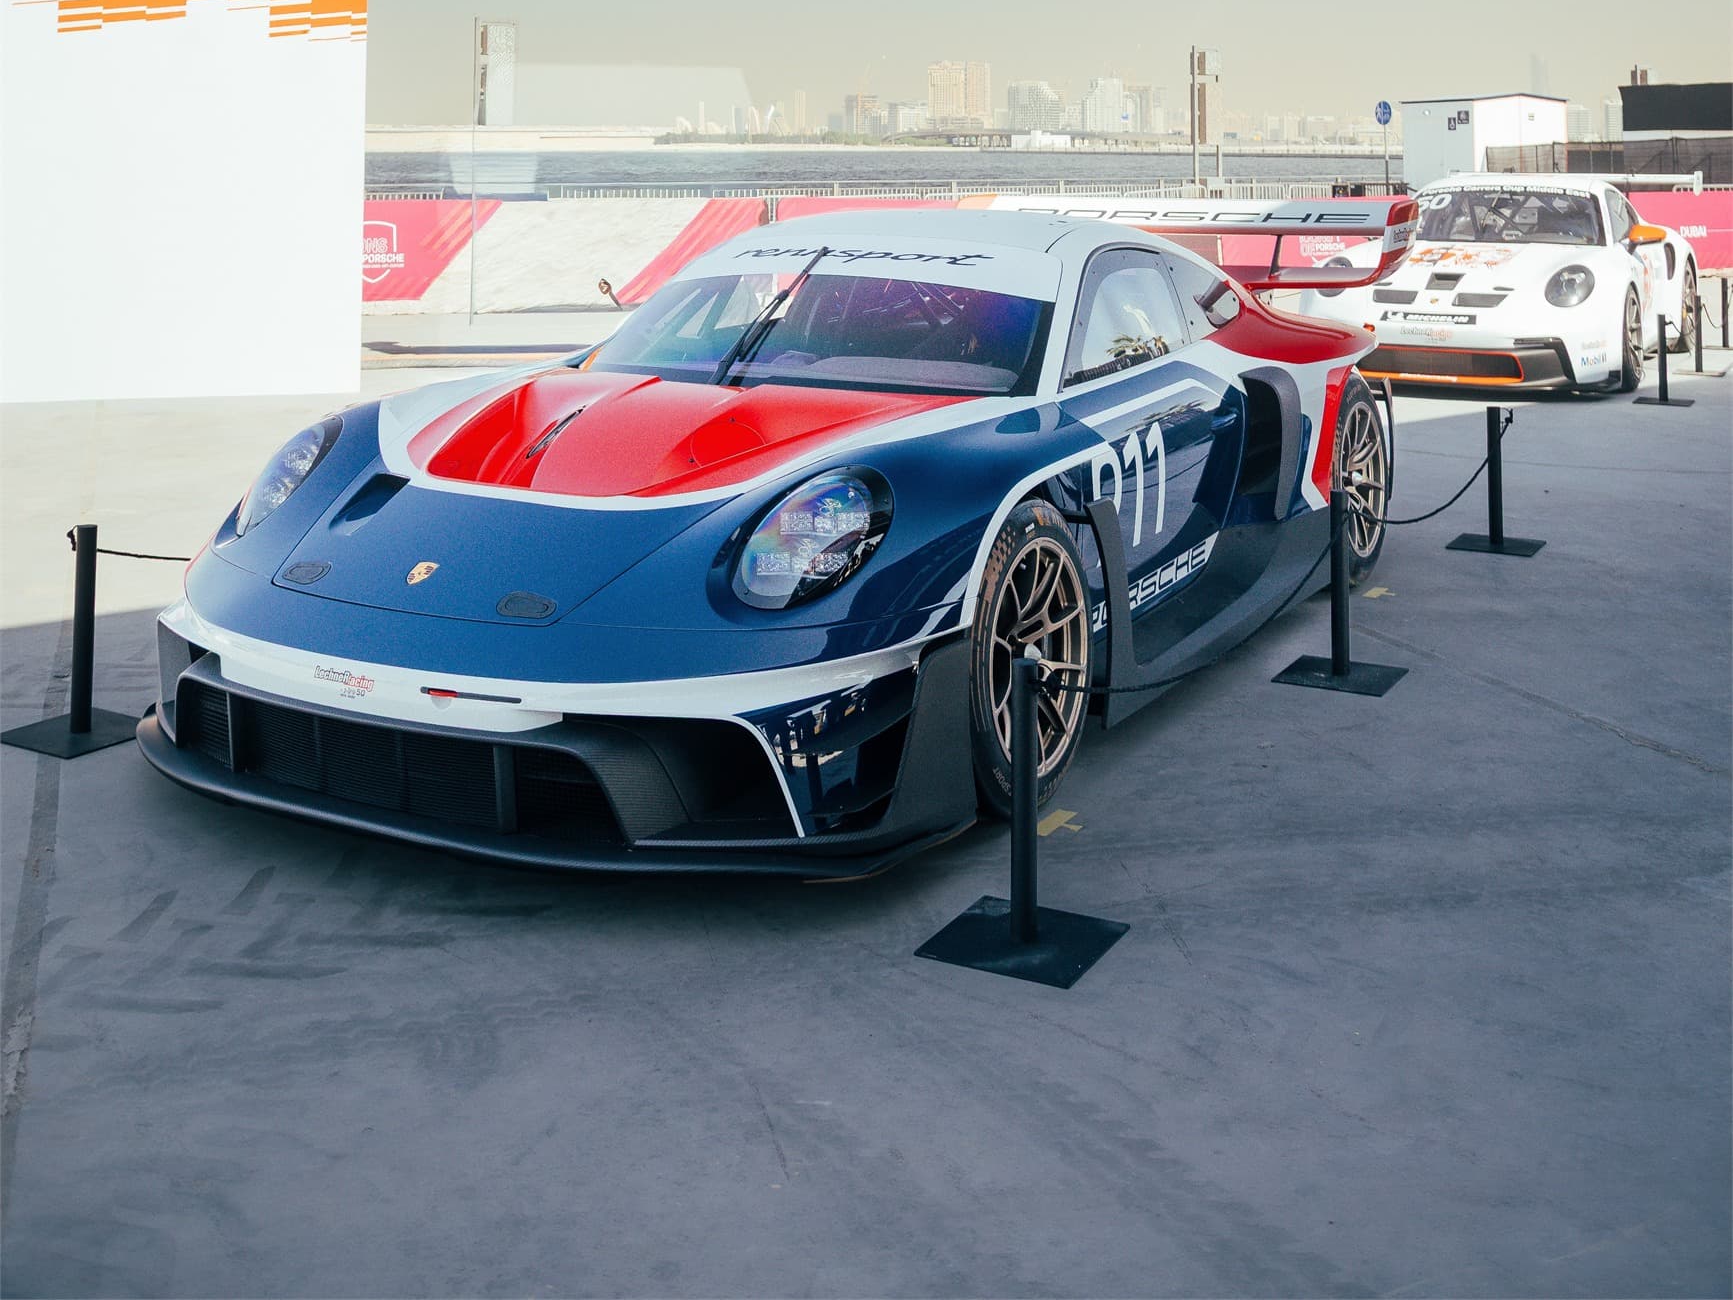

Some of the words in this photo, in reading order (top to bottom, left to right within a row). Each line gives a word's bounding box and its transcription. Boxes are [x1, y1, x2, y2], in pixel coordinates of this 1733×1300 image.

[1502, 185, 1525, 193] Cup
[1526, 186, 1564, 195] Middle
[1566, 188, 1590, 199] East
[1680, 225, 1708, 238] DUBAI
[1405, 314, 1470, 324] MICHELIN
[1091, 540, 1207, 626] PRSCHE
